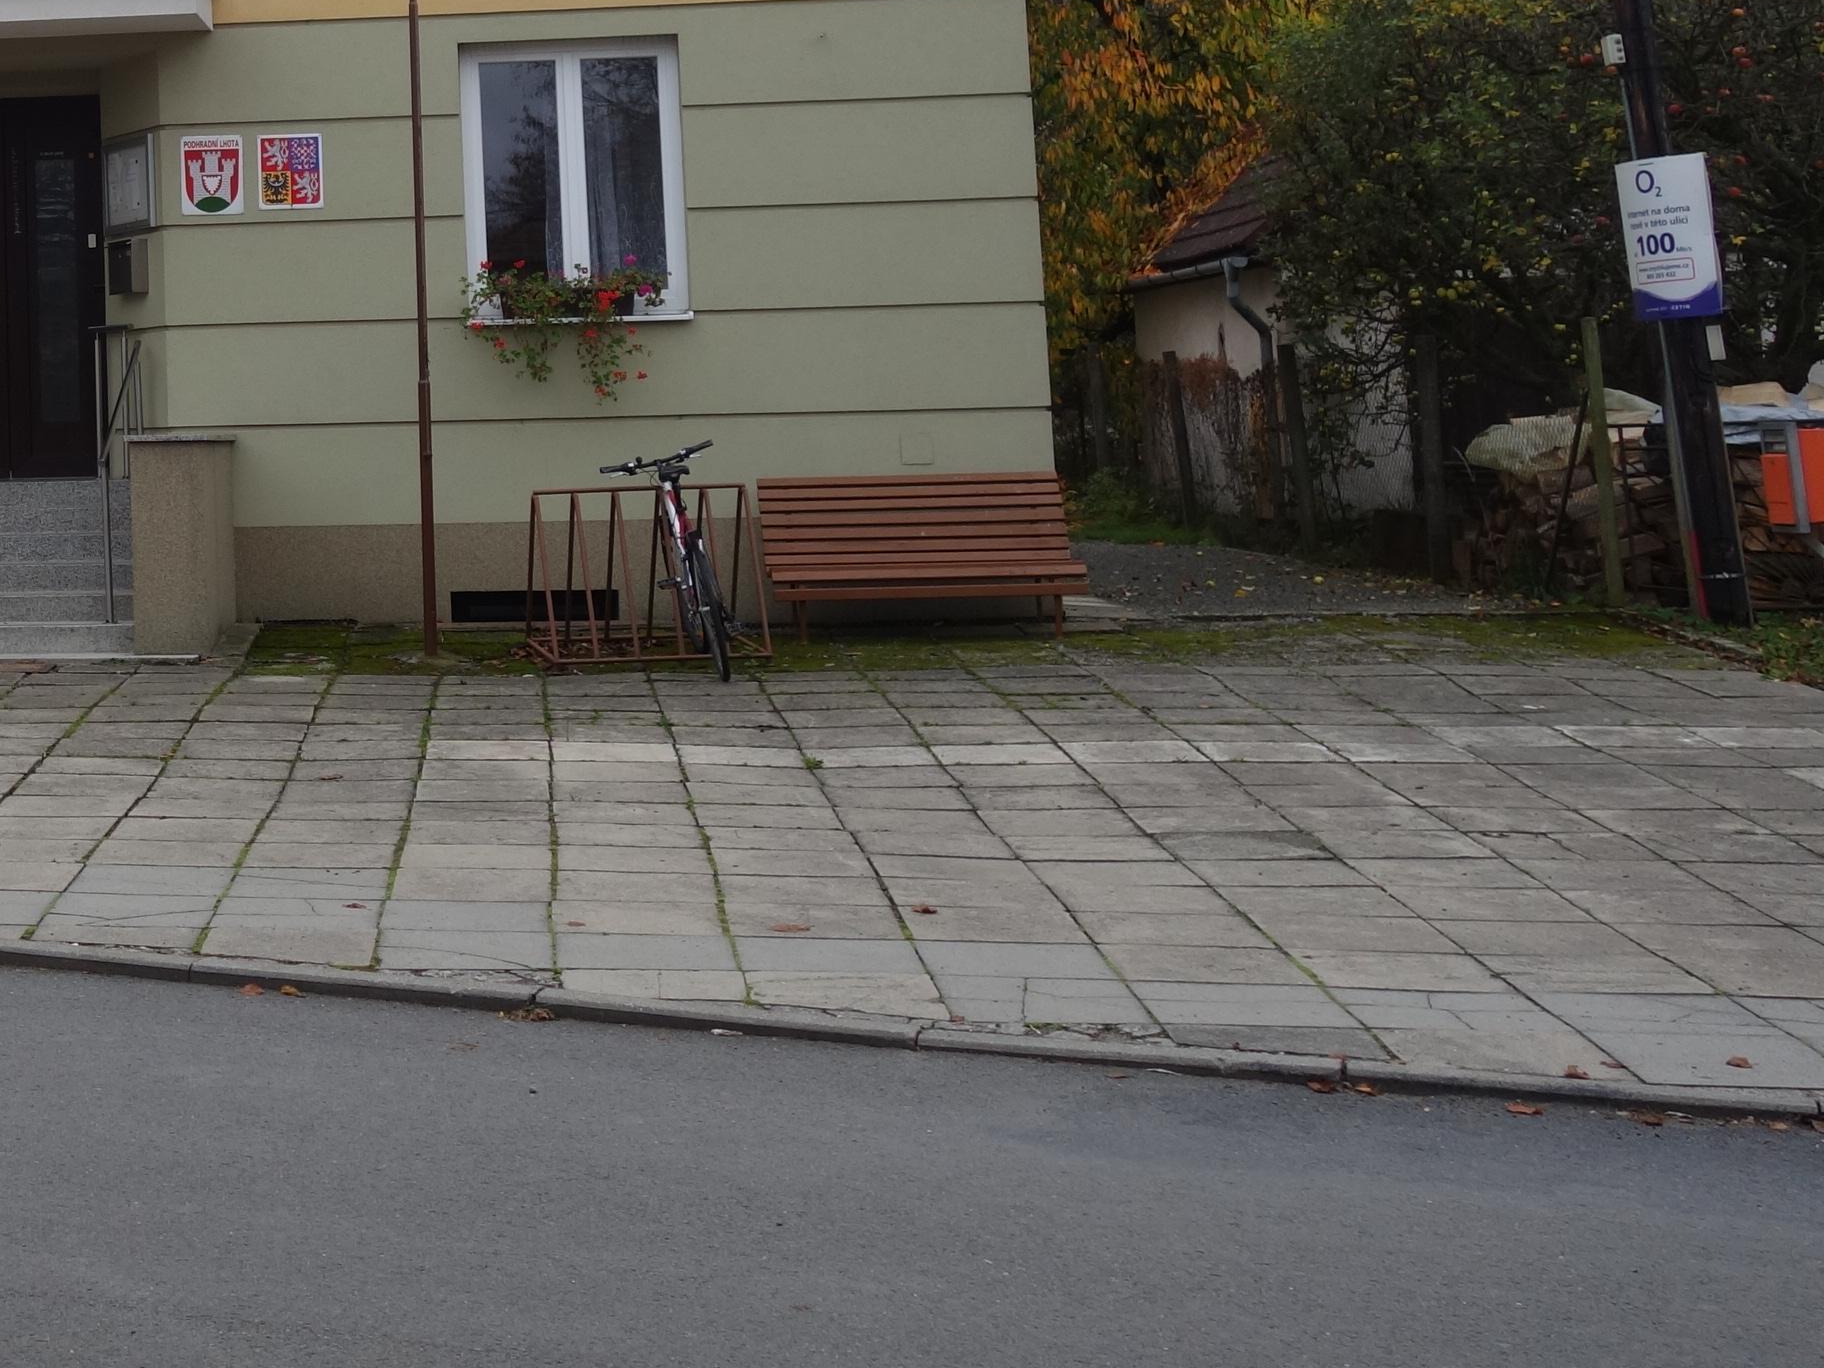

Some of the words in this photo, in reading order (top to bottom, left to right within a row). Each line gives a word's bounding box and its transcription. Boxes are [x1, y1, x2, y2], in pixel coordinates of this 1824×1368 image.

[183, 137, 218, 148] PODHRADNÍ
[219, 139, 239, 148] LHOTA
[1663, 205, 1691, 215] doma
[1670, 216, 1689, 226] ulici
[1636, 232, 1675, 257] 100
